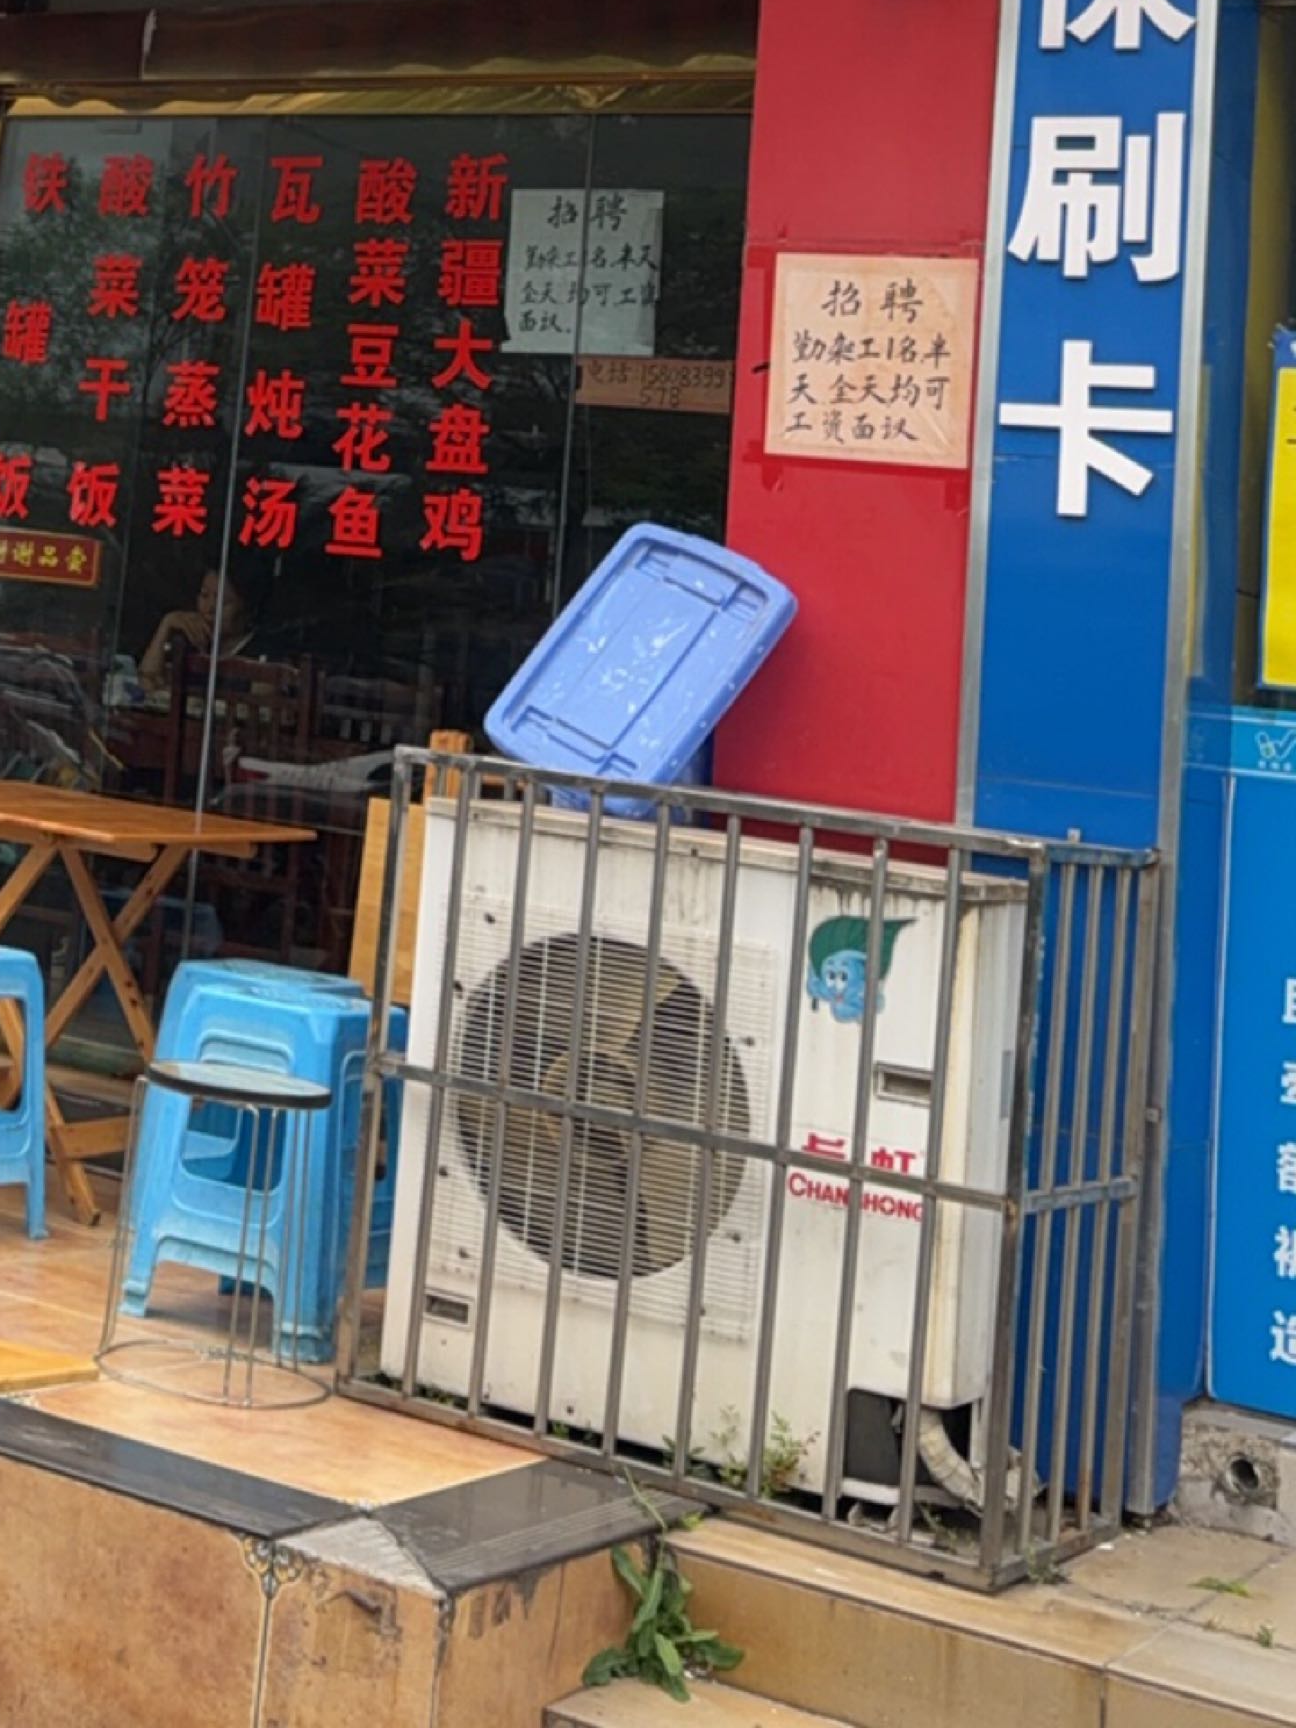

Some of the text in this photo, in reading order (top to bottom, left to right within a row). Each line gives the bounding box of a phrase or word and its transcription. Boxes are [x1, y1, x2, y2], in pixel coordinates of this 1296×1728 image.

[67, 152, 153, 528] 酸菜干饭
[152, 152, 237, 538] 竹笼蒸菜
[238, 155, 324, 549] 瓦罐炖汤
[325, 159, 417, 558] 酸菜豆花鱼
[419, 153, 508, 562] 新疆大盘鸡
[821, 278, 924, 323] 招聘
[788, 1171, 923, 1222] CHANHONG
